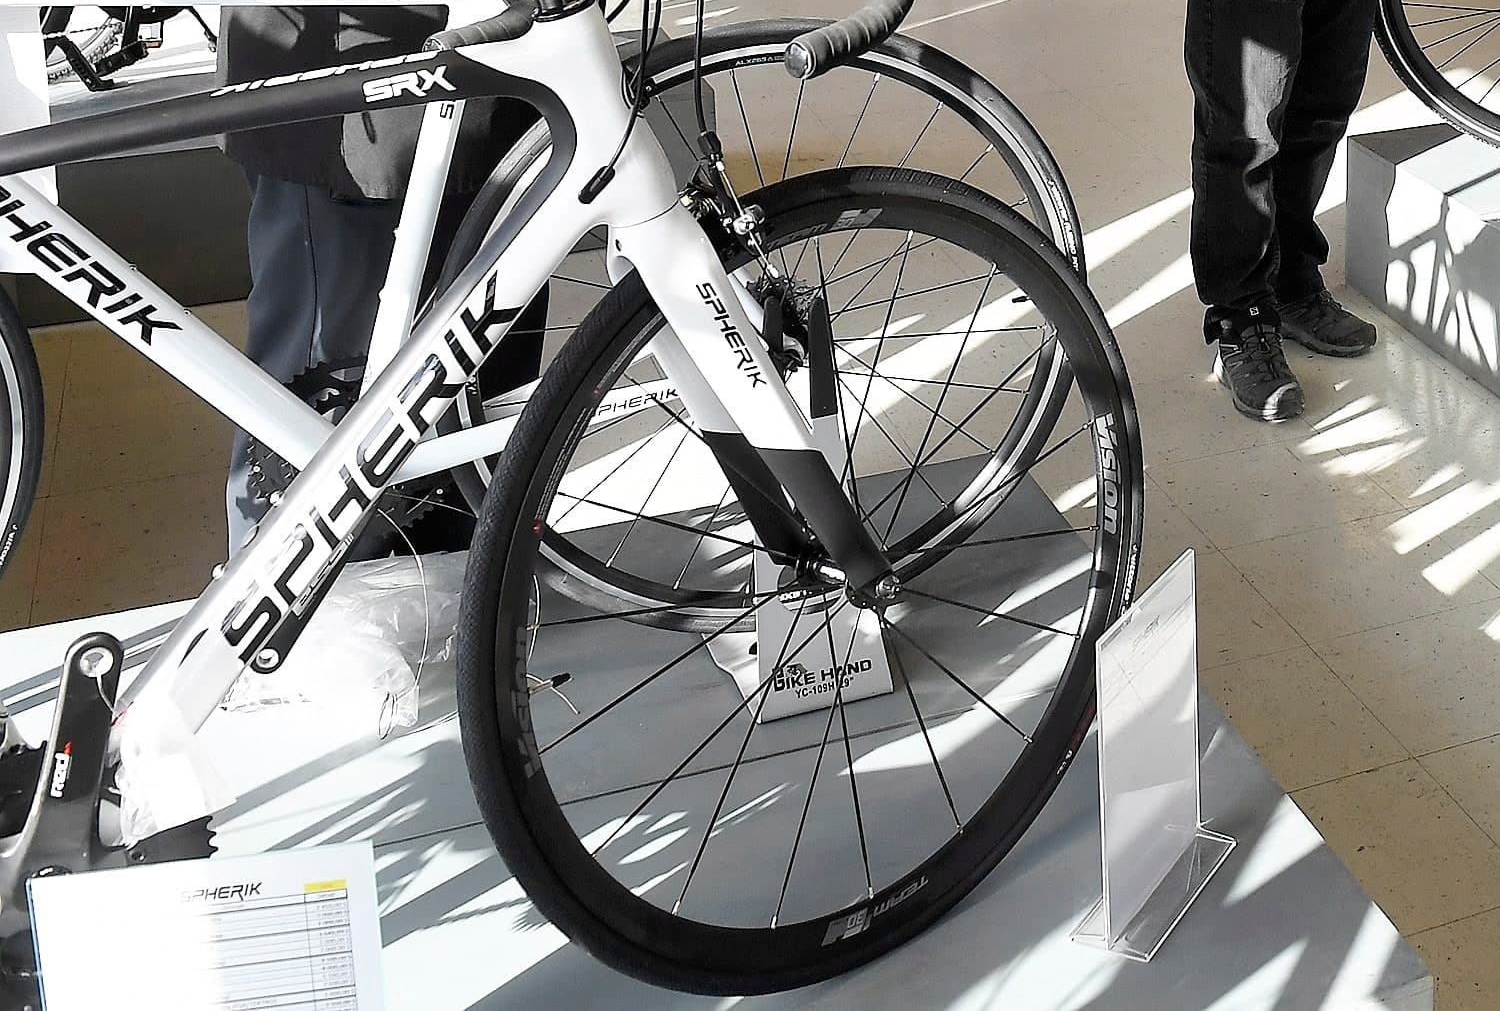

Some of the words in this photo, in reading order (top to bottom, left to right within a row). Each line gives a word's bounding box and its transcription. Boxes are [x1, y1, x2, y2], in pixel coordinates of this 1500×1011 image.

[363, 65, 457, 103] SRX
[0, 186, 183, 347] HERIK
[695, 282, 767, 388] SPHERIK
[597, 388, 680, 416] PHERIK
